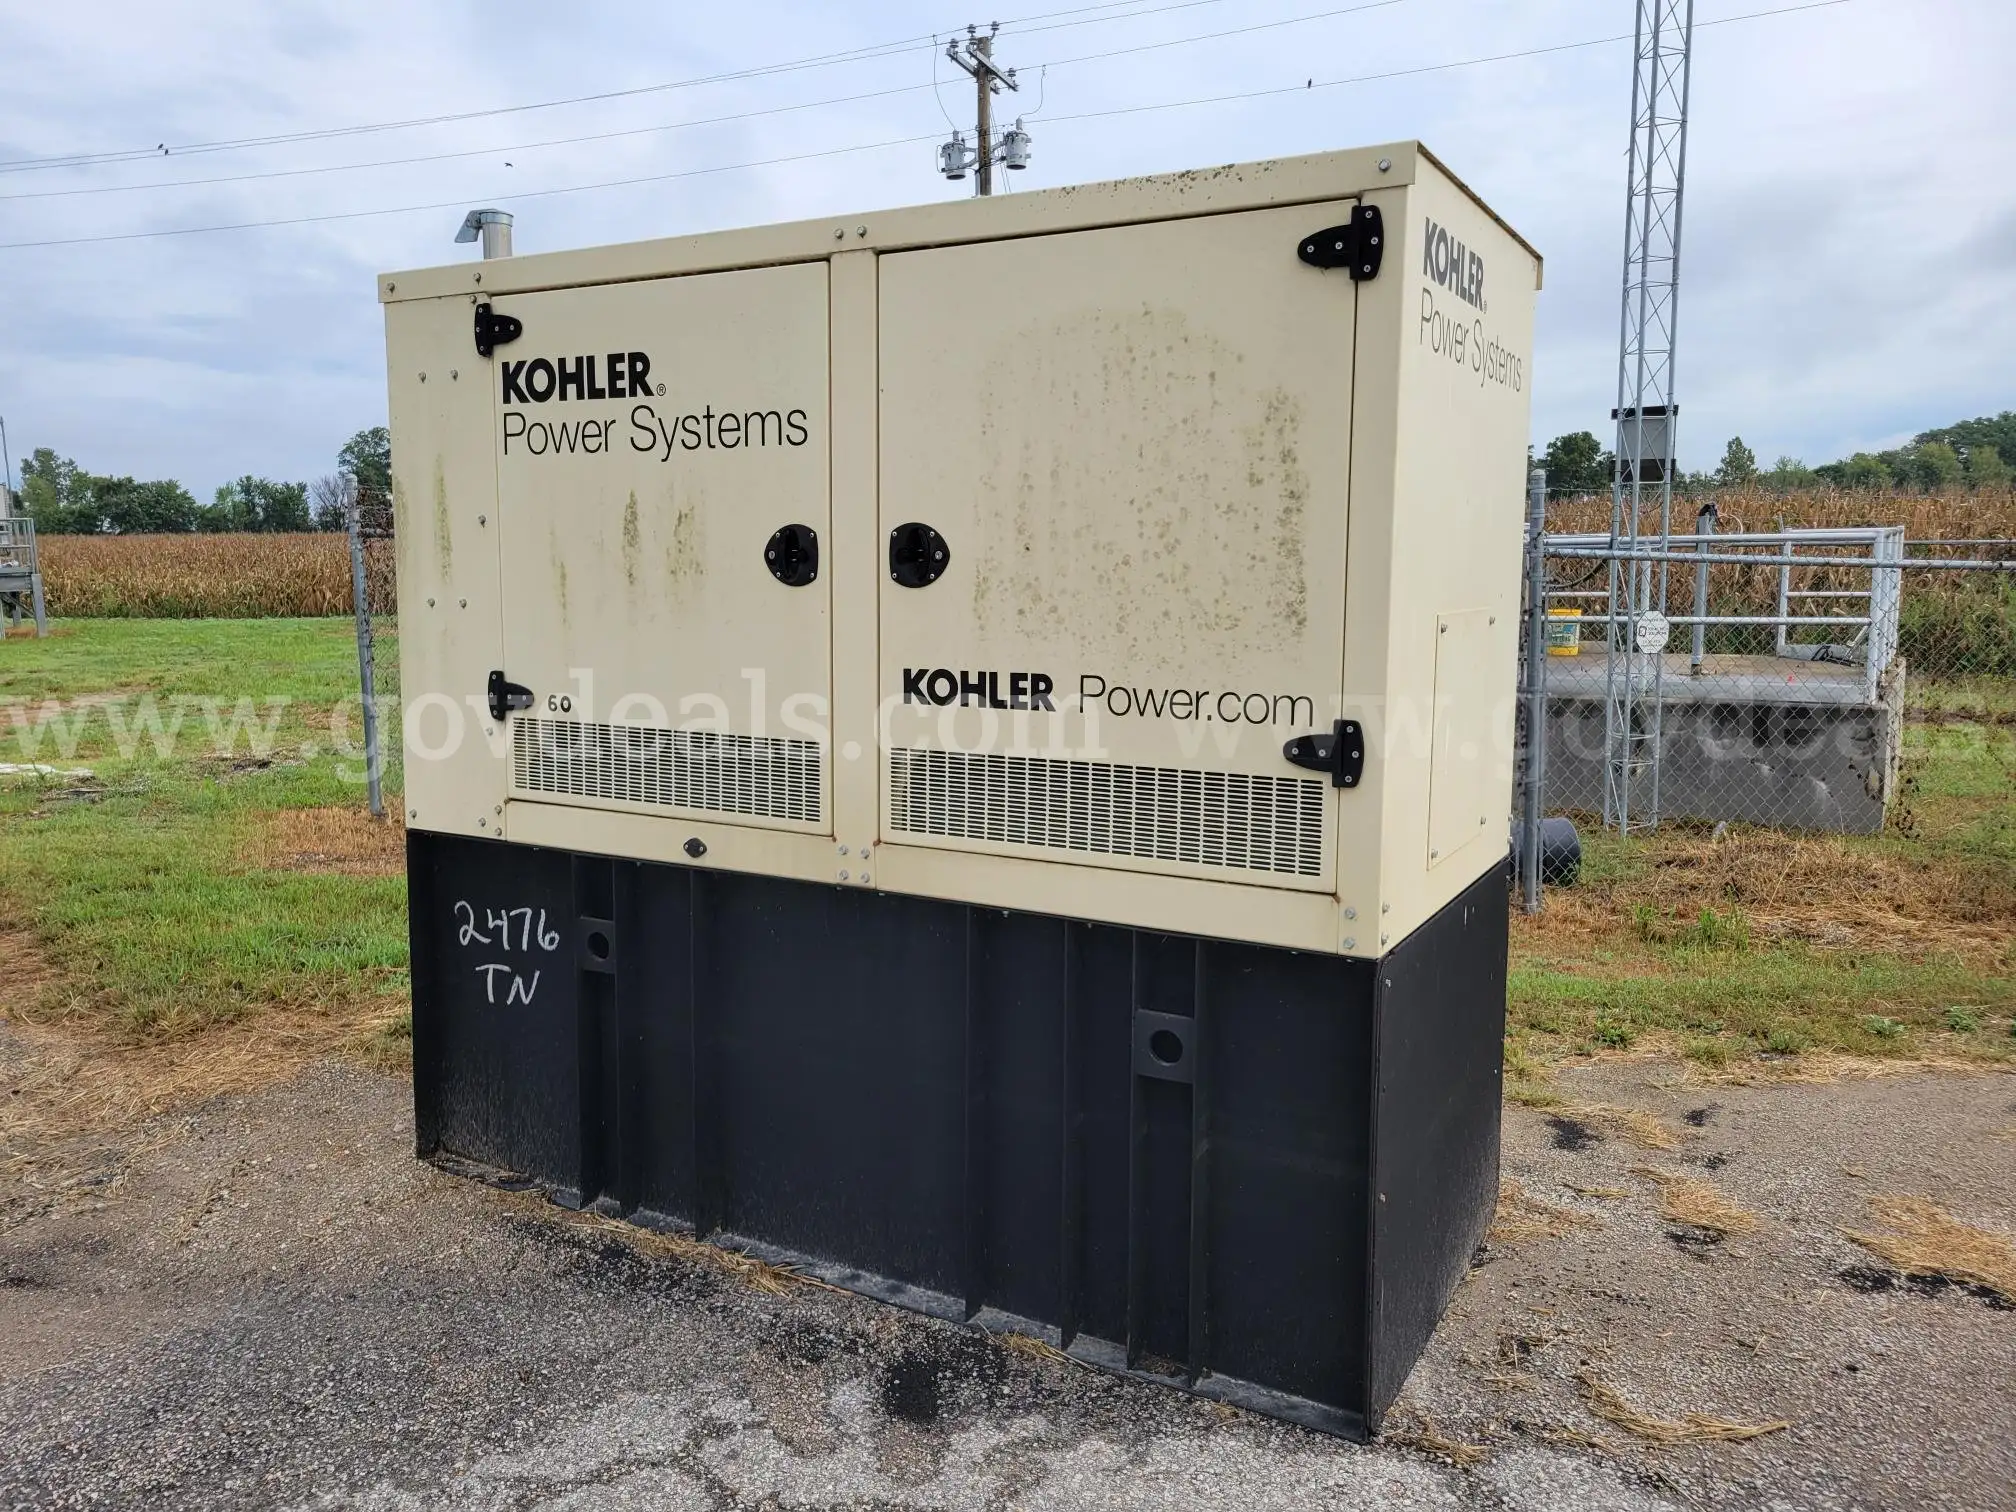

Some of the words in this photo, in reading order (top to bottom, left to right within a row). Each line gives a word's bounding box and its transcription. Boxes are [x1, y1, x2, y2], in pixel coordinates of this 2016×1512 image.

[1423, 216, 1484, 312] KOHLER
[1420, 287, 1469, 364] Power
[1471, 318, 1522, 393] Systems
[503, 412, 616, 455] Power
[630, 404, 809, 462] Systems
[547, 694, 572, 713] 60
[902, 668, 1056, 712] KOHLER
[1079, 674, 1313, 727] Power.com
[454, 900, 560, 952] 2476
[475, 963, 541, 1006] TN
